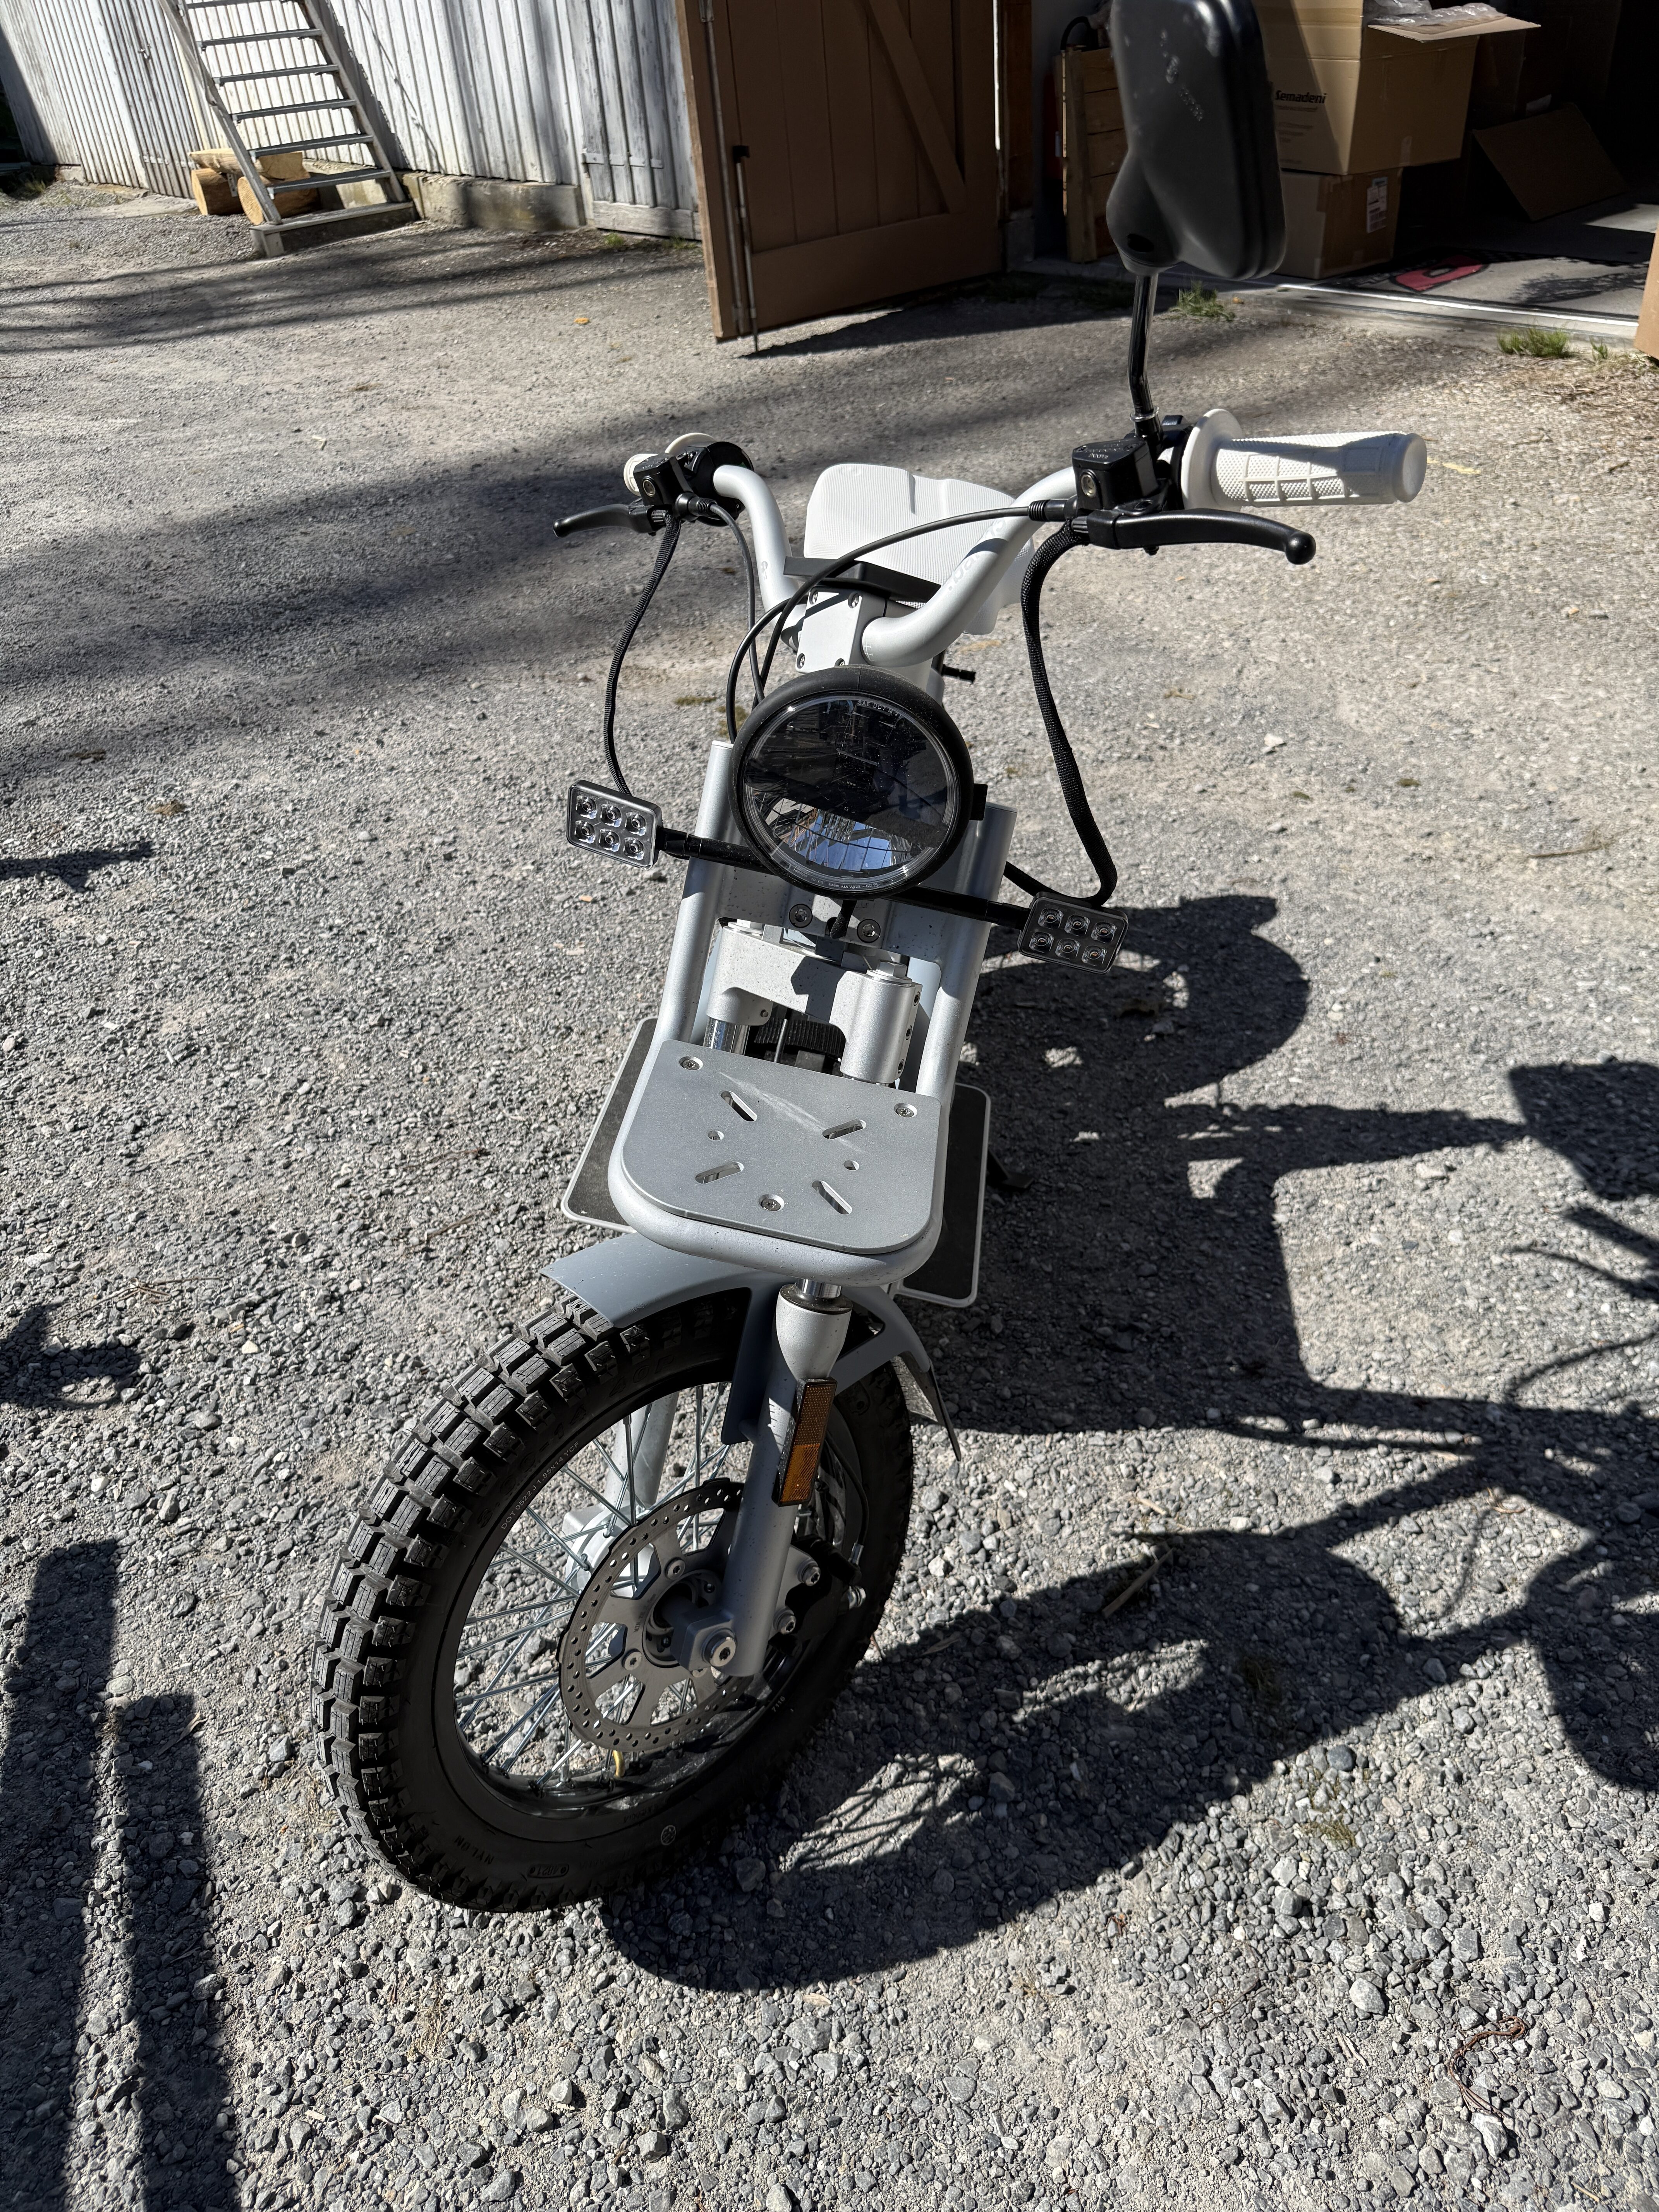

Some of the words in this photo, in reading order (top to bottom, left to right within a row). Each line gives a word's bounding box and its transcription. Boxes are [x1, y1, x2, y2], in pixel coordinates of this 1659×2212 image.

[1275, 89, 1328, 103] Semadeni
[501, 1510, 516, 1529] DOT
[515, 1491, 532, 1510] 0522
[563, 1441, 580, 1456] YCF
[454, 1834, 494, 1865] NYLON
